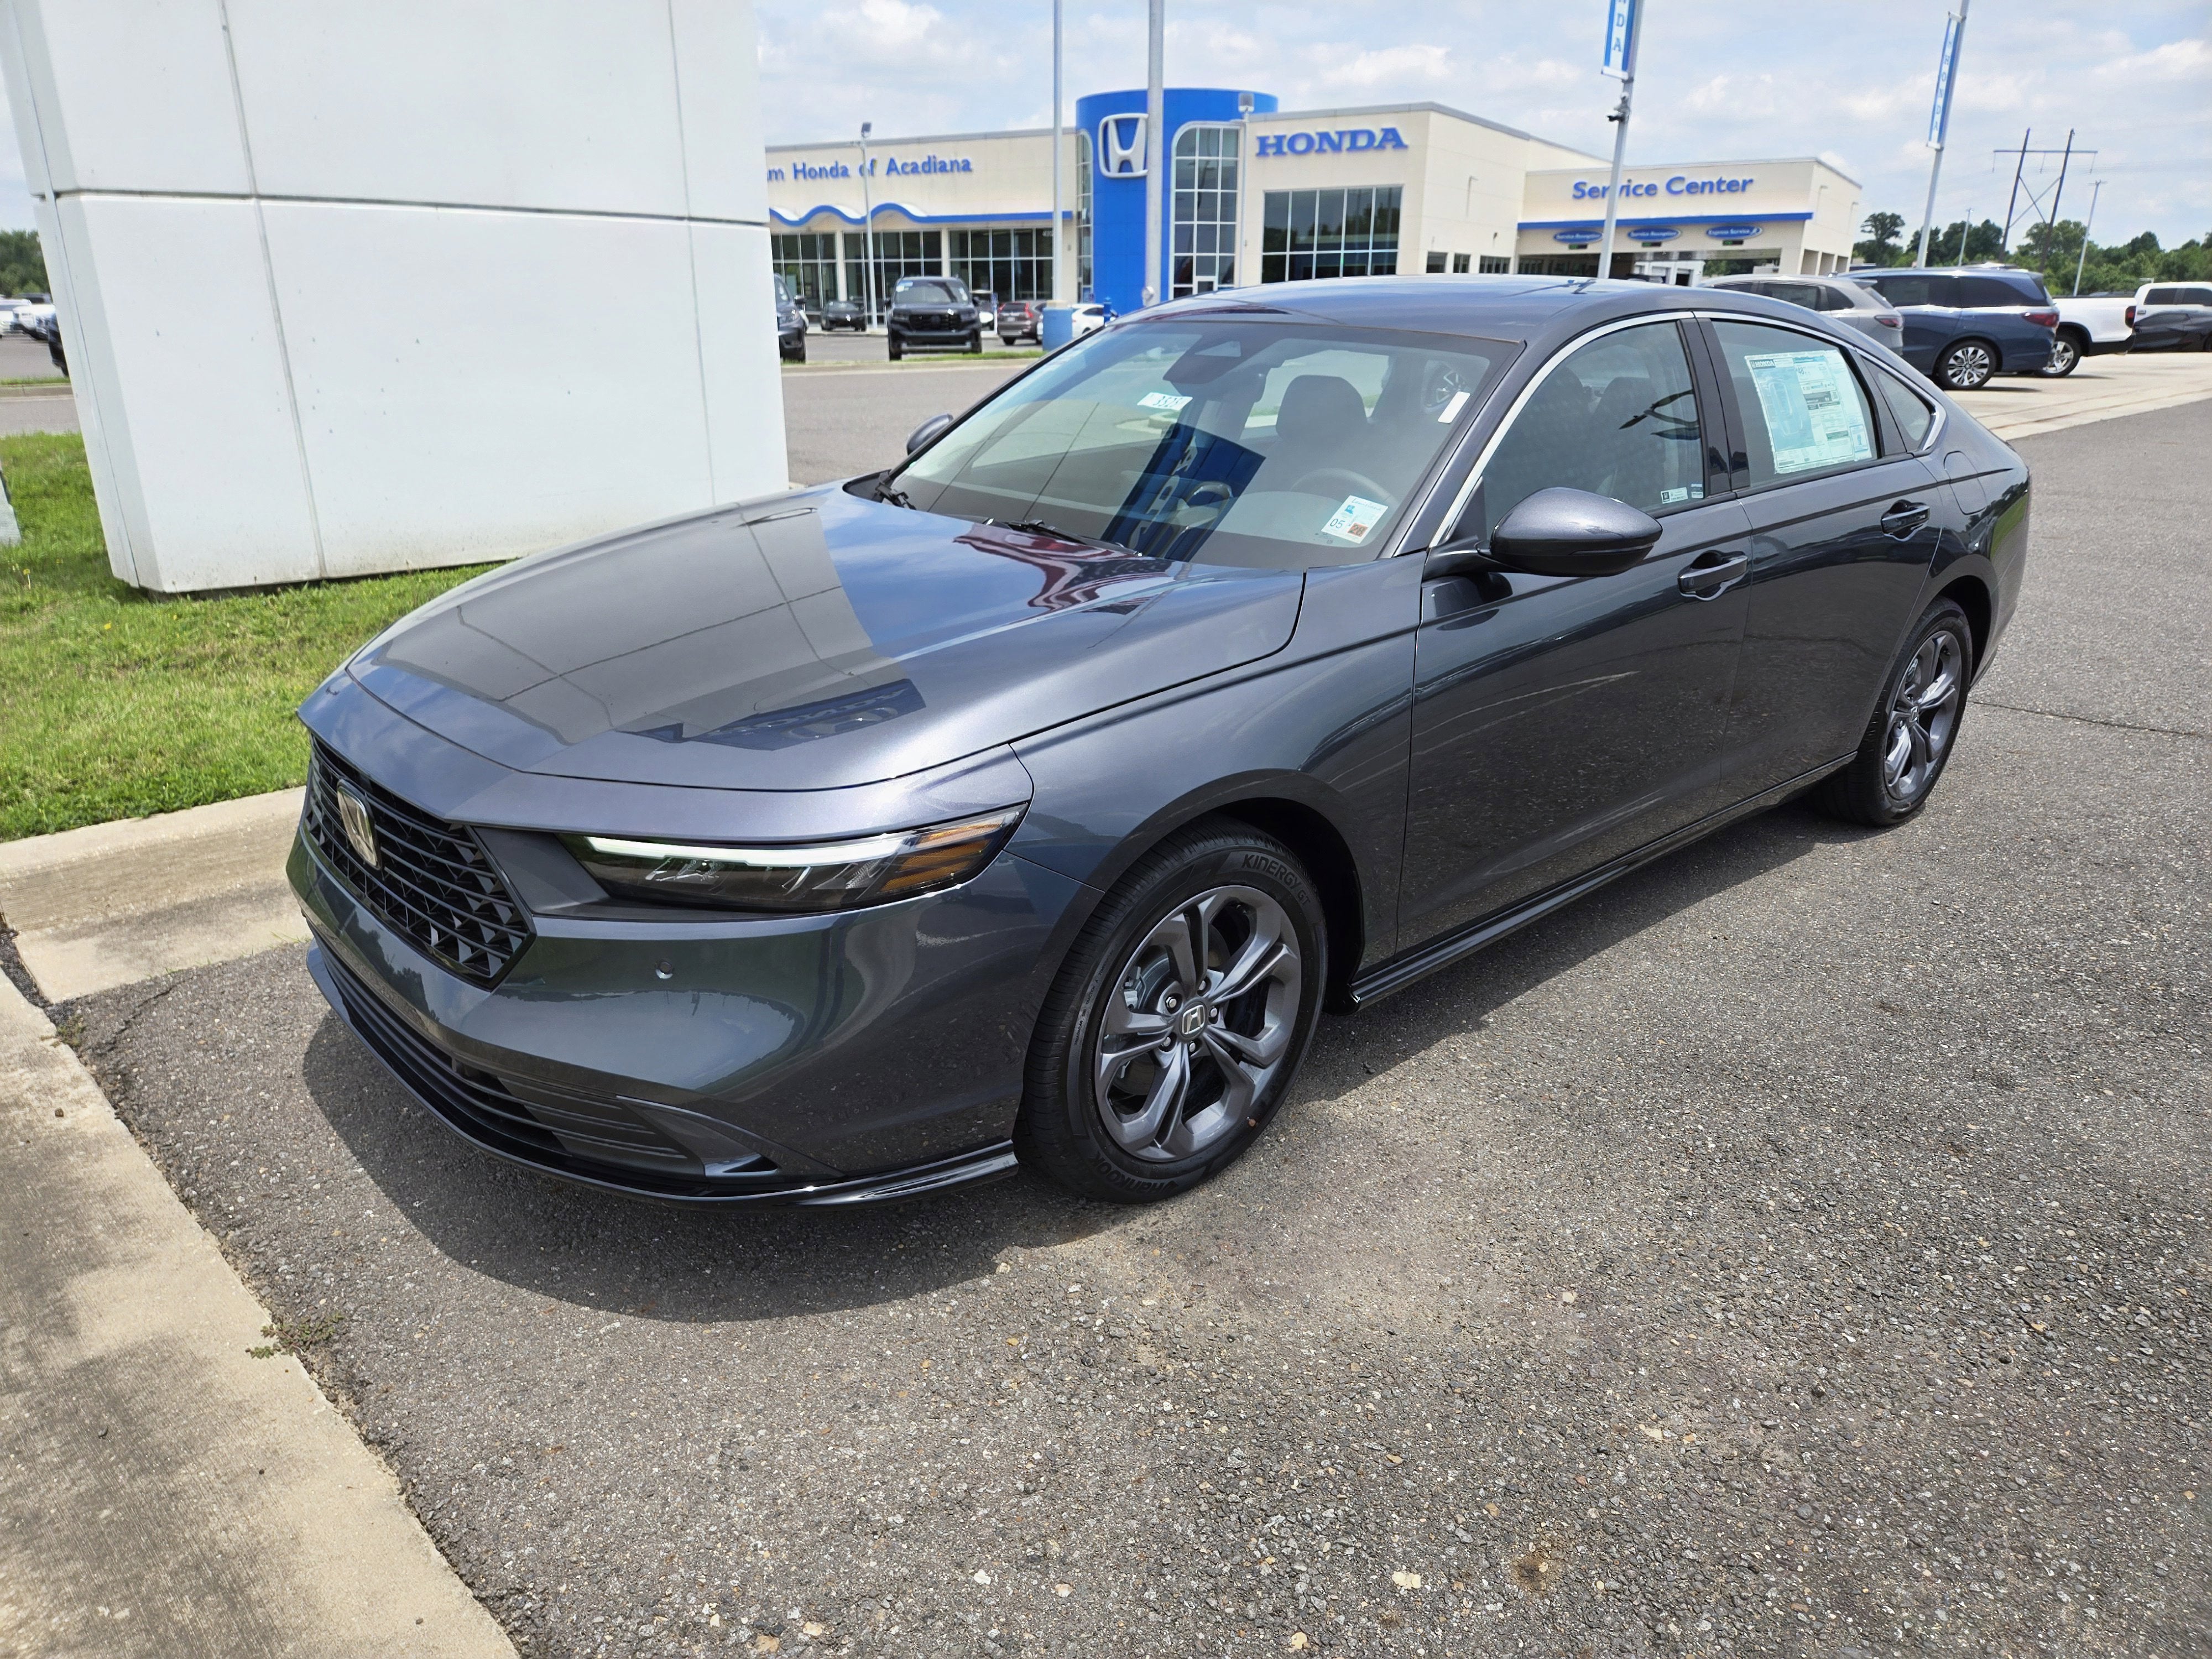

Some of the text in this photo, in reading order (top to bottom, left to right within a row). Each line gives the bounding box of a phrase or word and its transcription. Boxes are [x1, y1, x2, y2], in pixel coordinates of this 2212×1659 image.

[1933, 55, 1949, 131] HONDA
[1256, 127, 1408, 157] HONDA
[793, 161, 849, 180] Honda
[858, 158, 878, 177] of
[886, 154, 972, 176] Acadiana
[1666, 176, 1754, 195] Center
[1754, 359, 1775, 368] HONDA
[1352, 498, 1381, 511] Louisiana
[1330, 518, 1345, 529] 05
[1350, 525, 1365, 535] 28
[1241, 854, 1311, 905] KINERGY GT
